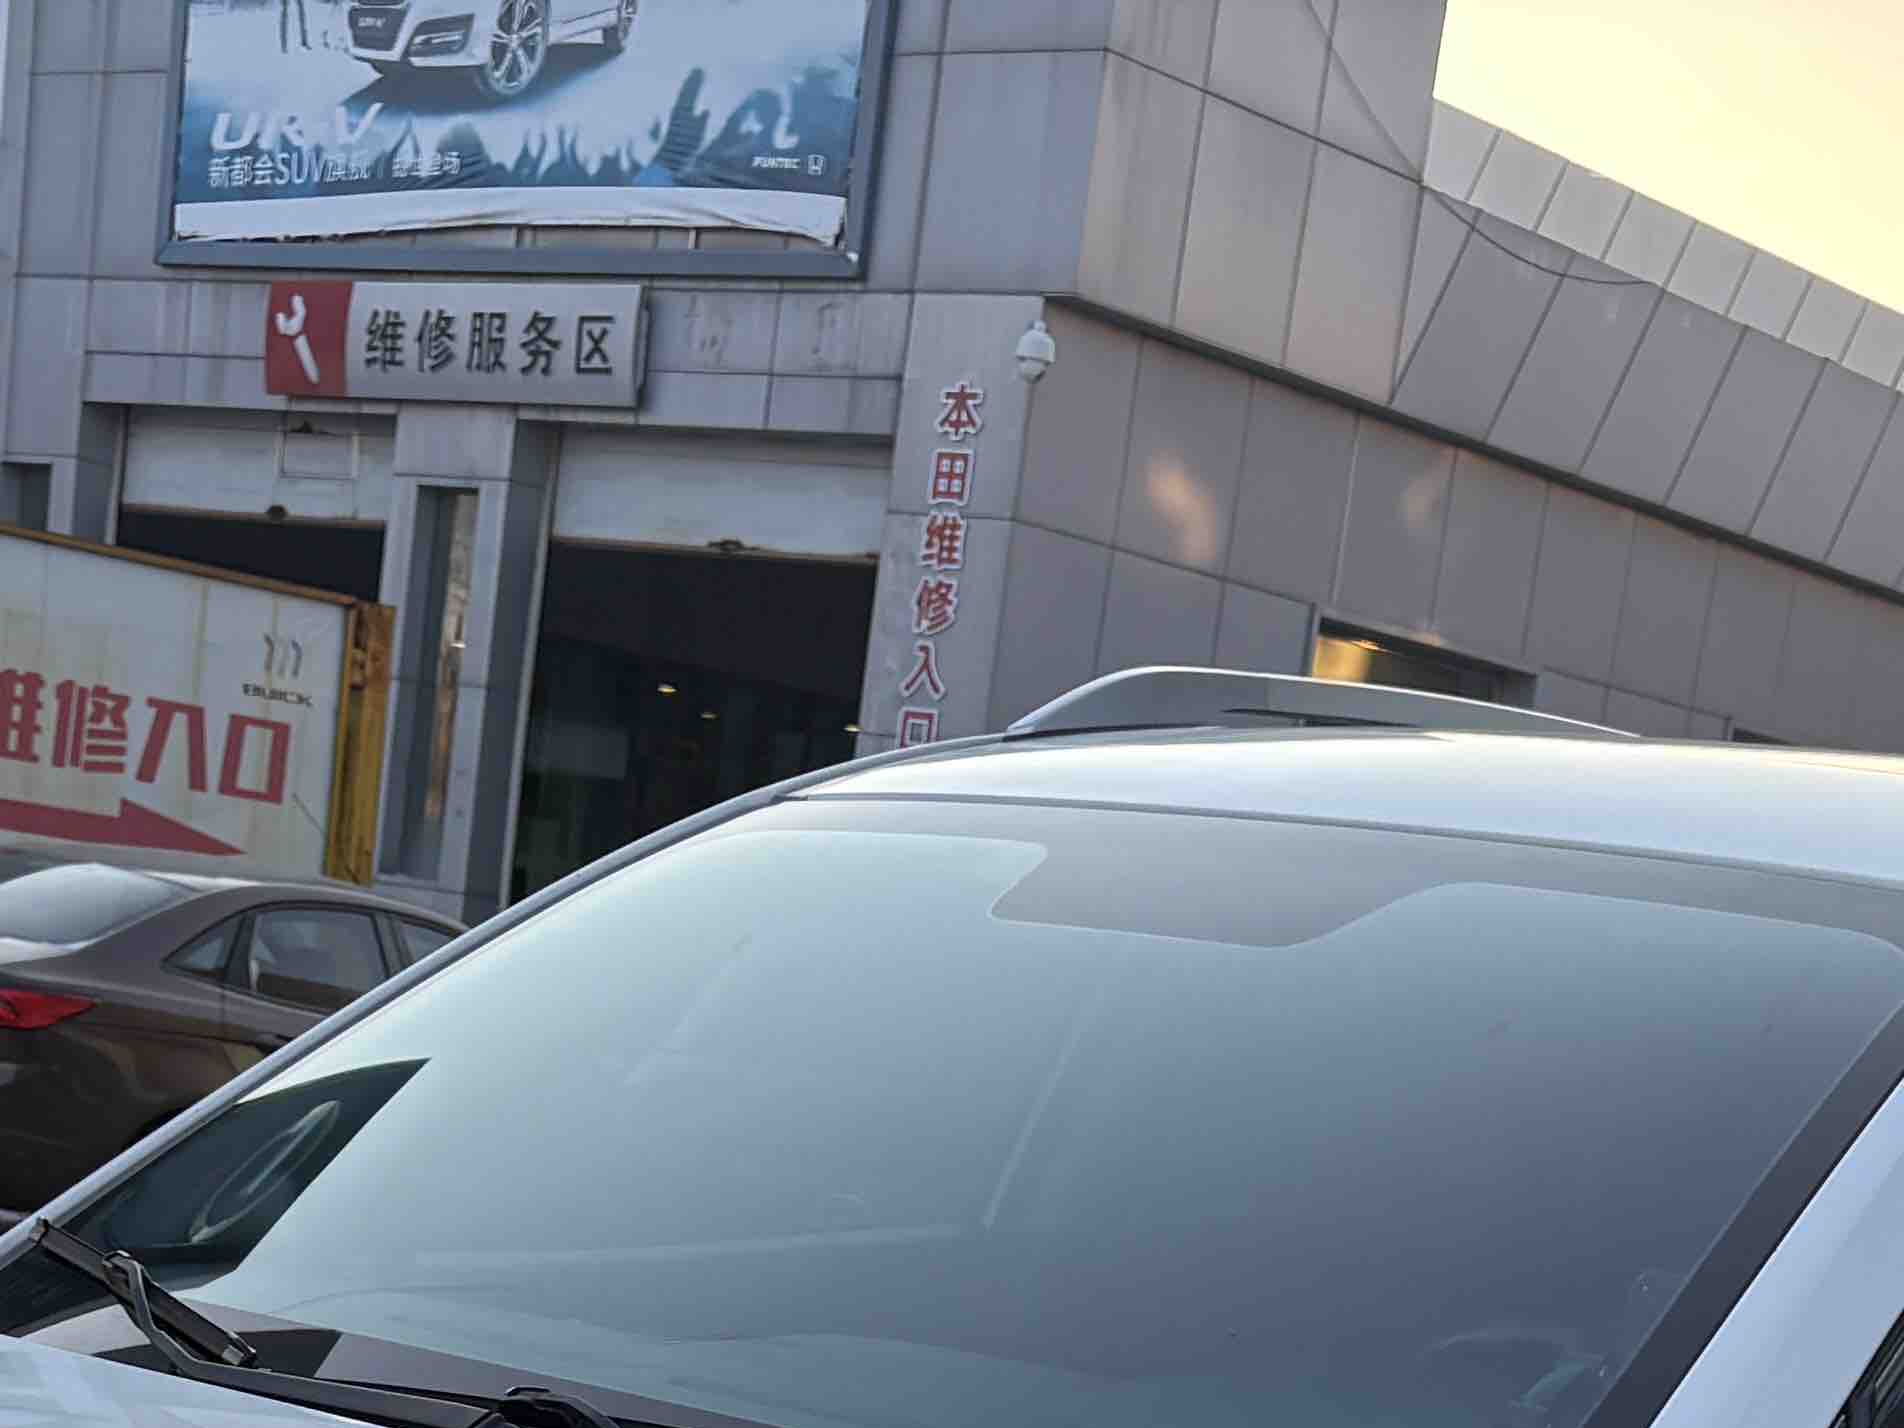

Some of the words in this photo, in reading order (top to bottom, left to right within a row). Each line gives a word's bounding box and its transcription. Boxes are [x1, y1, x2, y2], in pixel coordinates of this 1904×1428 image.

[364, 309, 617, 376] 维修服务区
[899, 382, 984, 749] 本田维修入口
